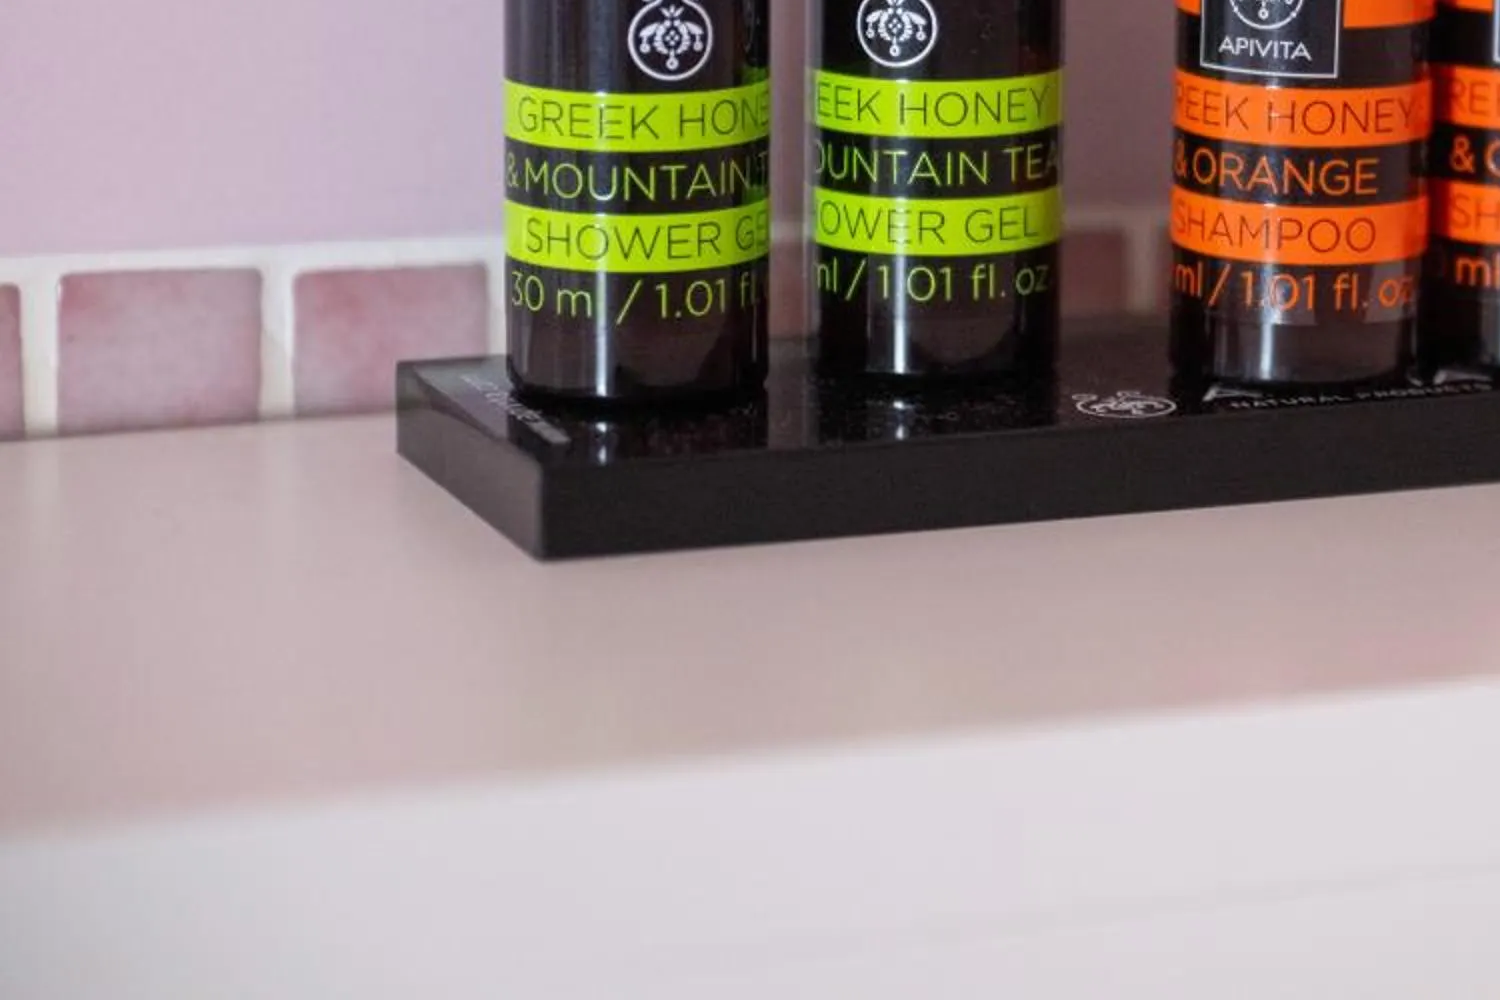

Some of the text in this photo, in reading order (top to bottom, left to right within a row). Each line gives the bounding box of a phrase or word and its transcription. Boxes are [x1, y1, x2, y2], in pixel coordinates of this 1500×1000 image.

[1217, 35, 1313, 61] APIVITA
[517, 96, 660, 141] GREEK
[900, 83, 1051, 127] HONEY
[1266, 97, 1417, 137] HONEY
[1192, 149, 1380, 197] ORANGE
[1451, 134, 1476, 174] &
[524, 158, 751, 202] MOUNTAIN
[525, 216, 722, 262] SHOWER
[965, 204, 1041, 245] GEL
[1173, 197, 1377, 255] SHAMPOO
[511, 270, 545, 312] 30
[557, 281, 604, 319] m
[655, 278, 726, 319] 1.01
[878, 264, 952, 302] 101
[971, 262, 1006, 300] fl.
